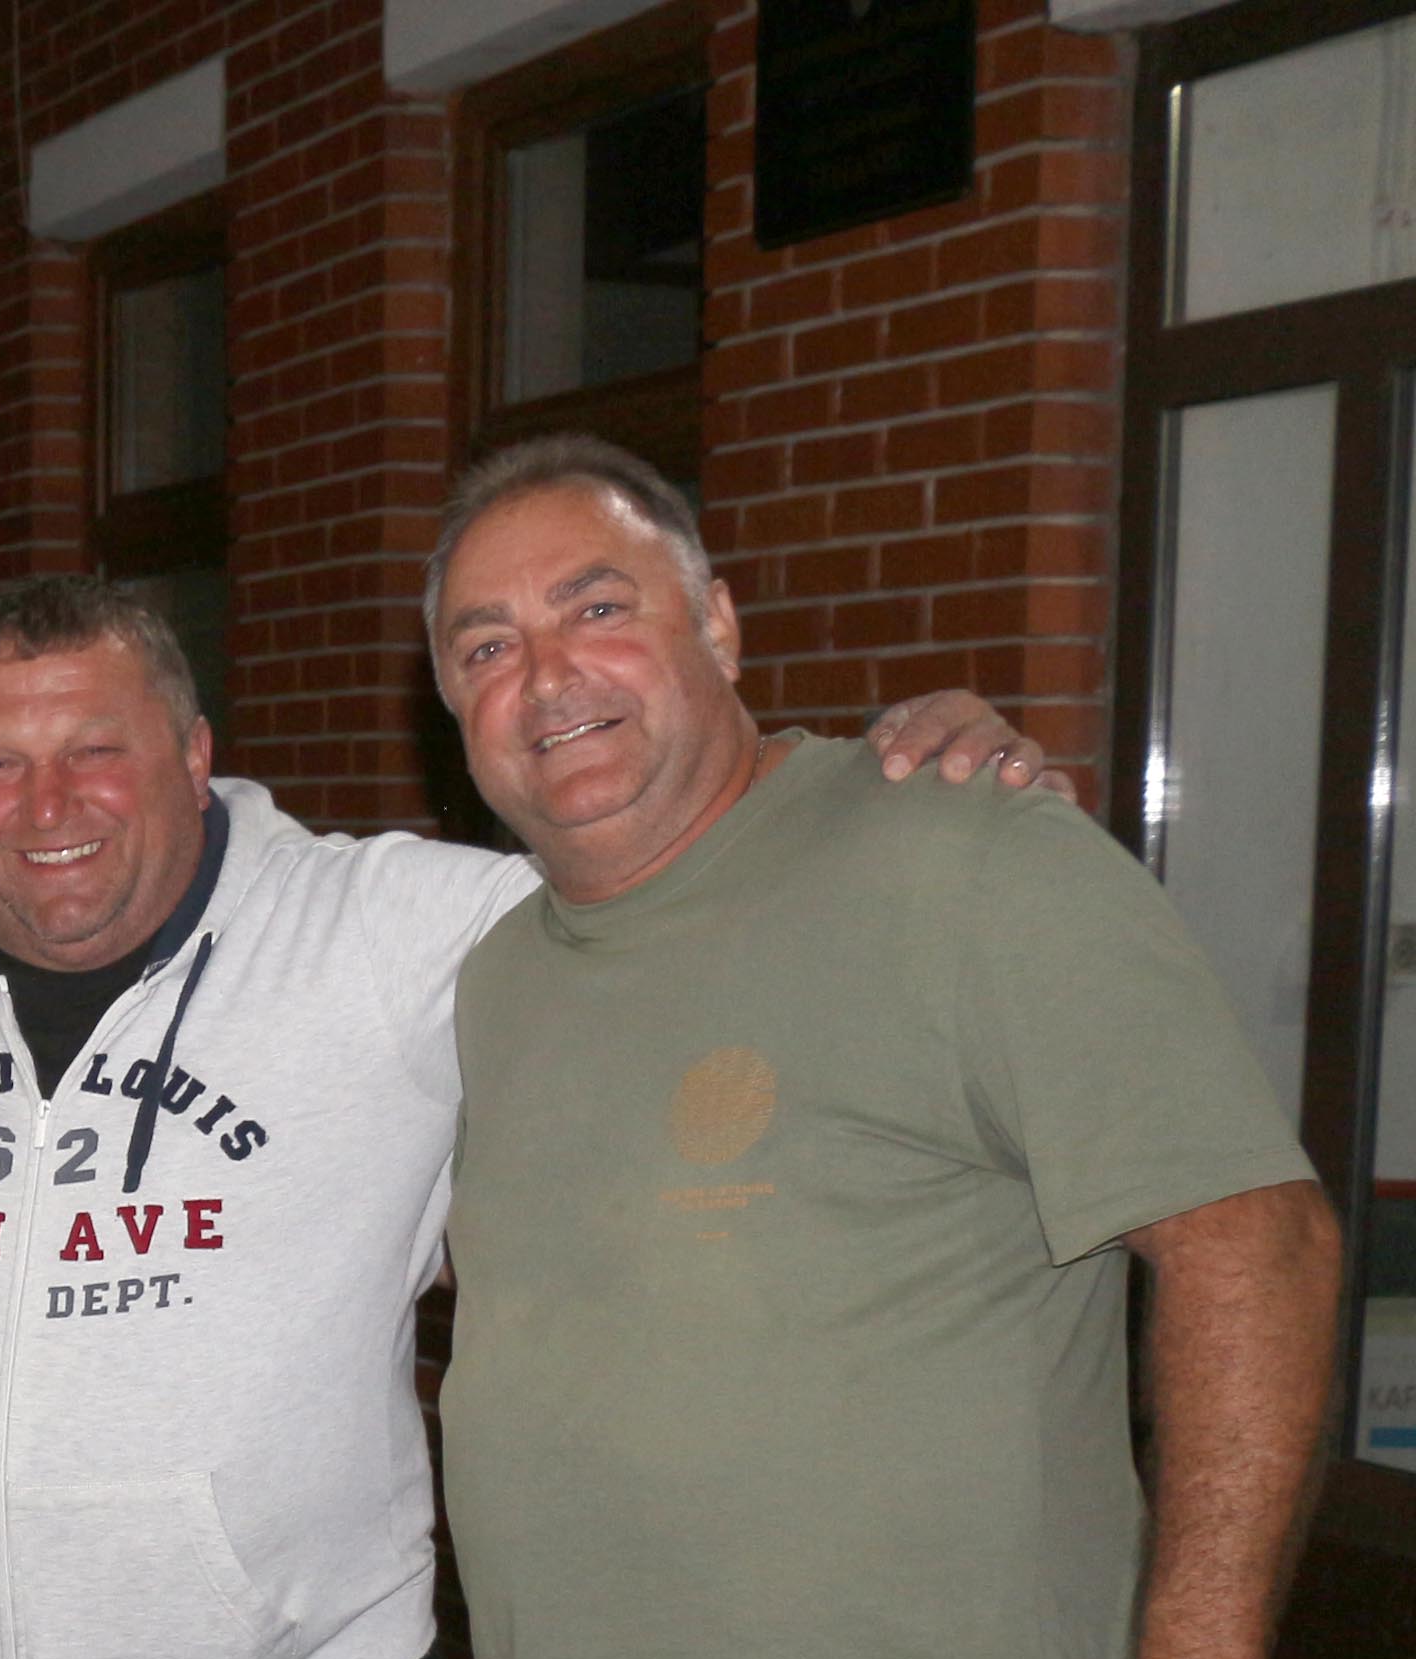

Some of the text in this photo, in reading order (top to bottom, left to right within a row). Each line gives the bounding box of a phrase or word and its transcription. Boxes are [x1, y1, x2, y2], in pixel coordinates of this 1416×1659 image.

[80, 1053, 267, 1161] LOUIS
[59, 1199, 224, 1261] AVE
[45, 1273, 193, 1319] DEPT.
